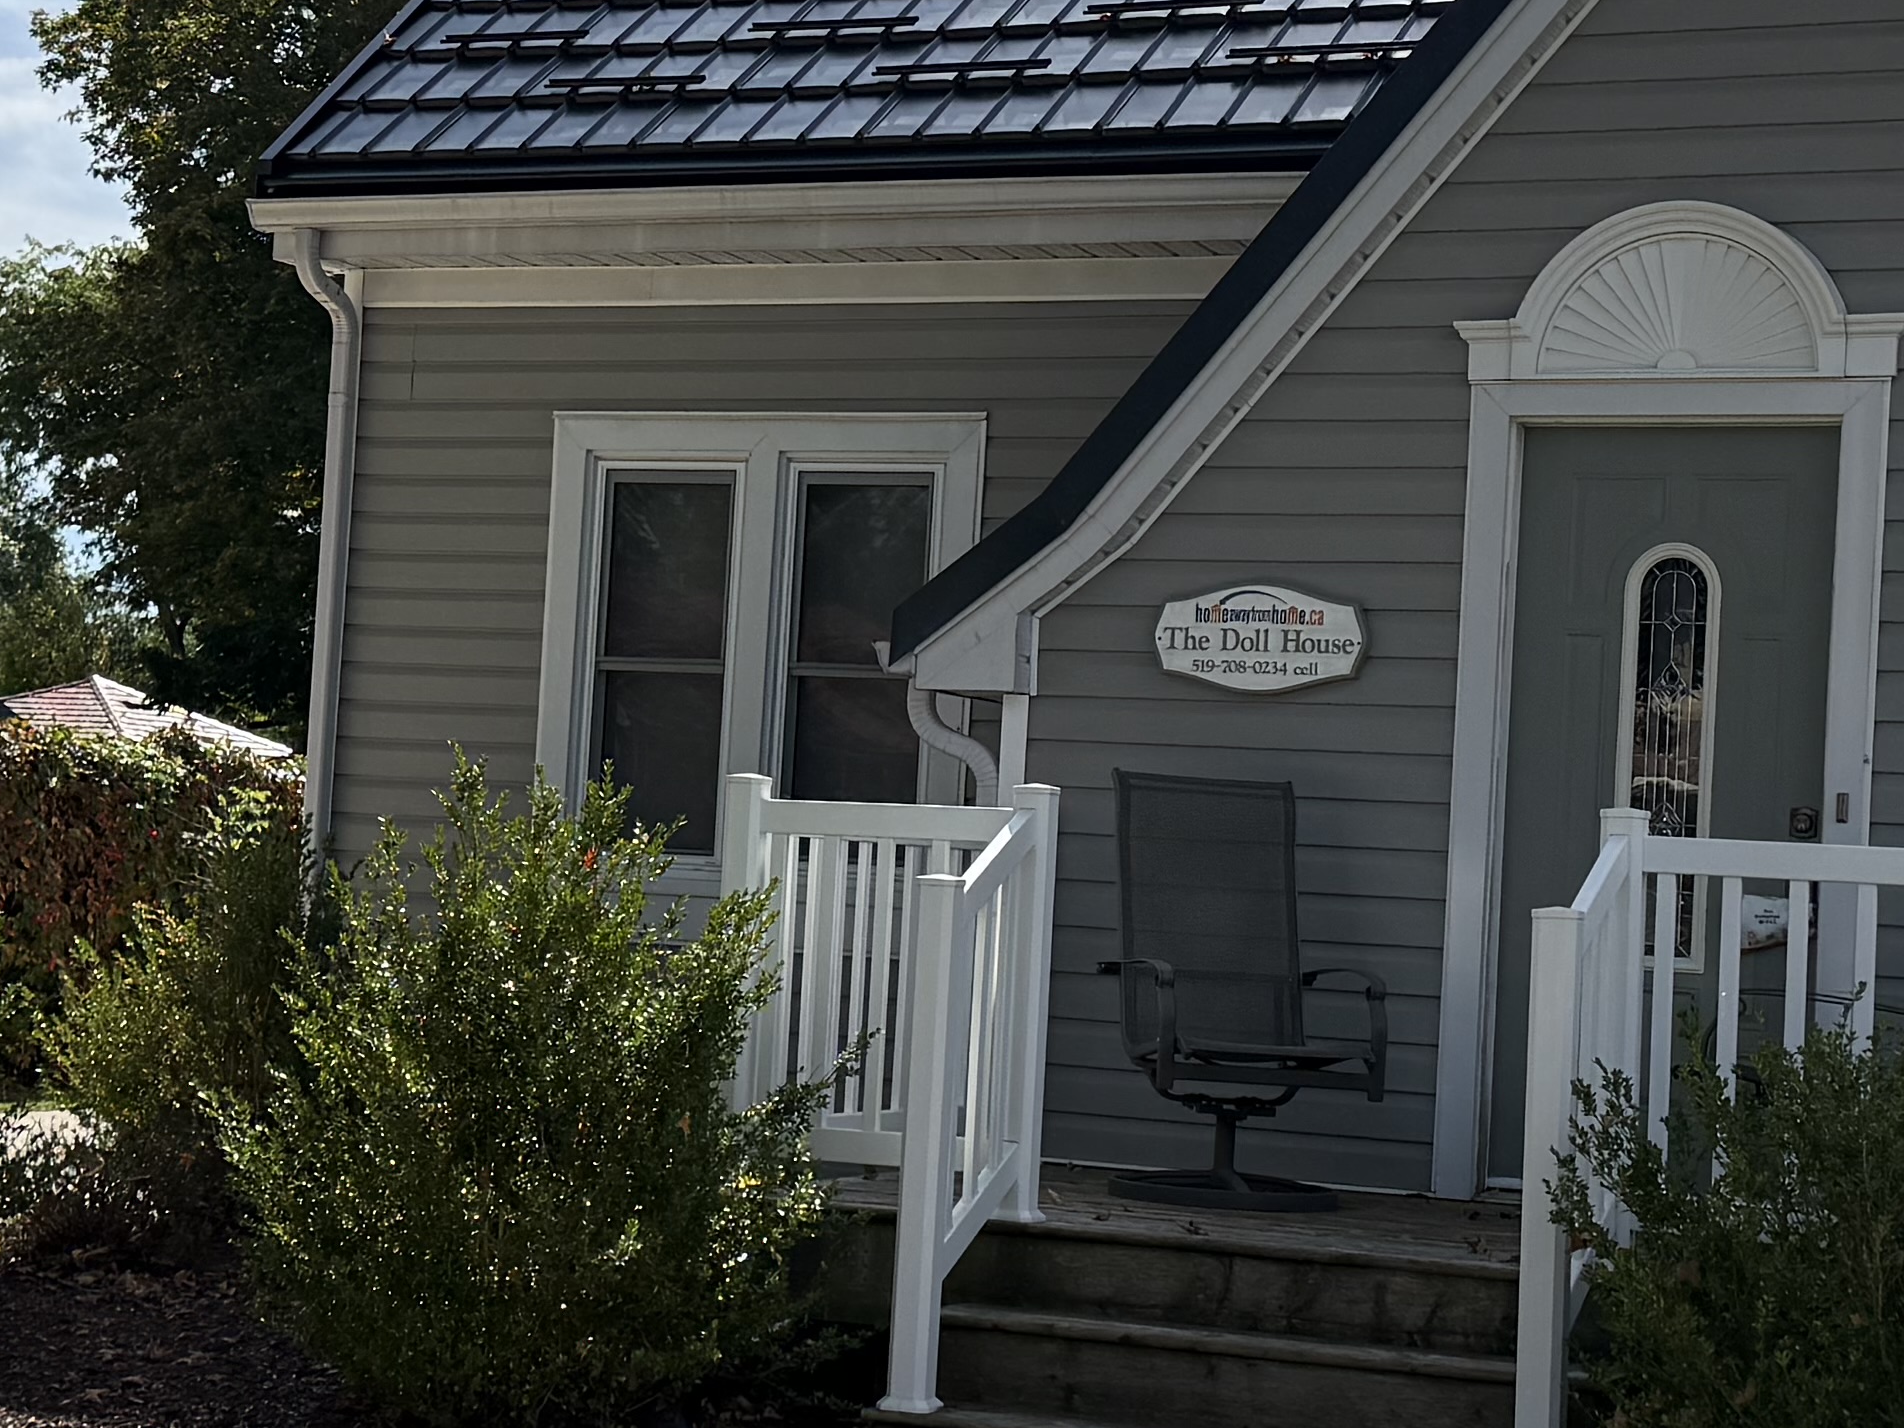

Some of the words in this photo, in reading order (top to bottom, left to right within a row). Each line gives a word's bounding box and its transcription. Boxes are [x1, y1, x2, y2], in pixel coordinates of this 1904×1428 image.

[1162, 626, 1211, 651] The
[1220, 627, 1270, 653] Doll
[1280, 629, 1355, 655] House
[1191, 659, 1288, 676] 519-708-0234
[1293, 661, 1319, 676] cell
